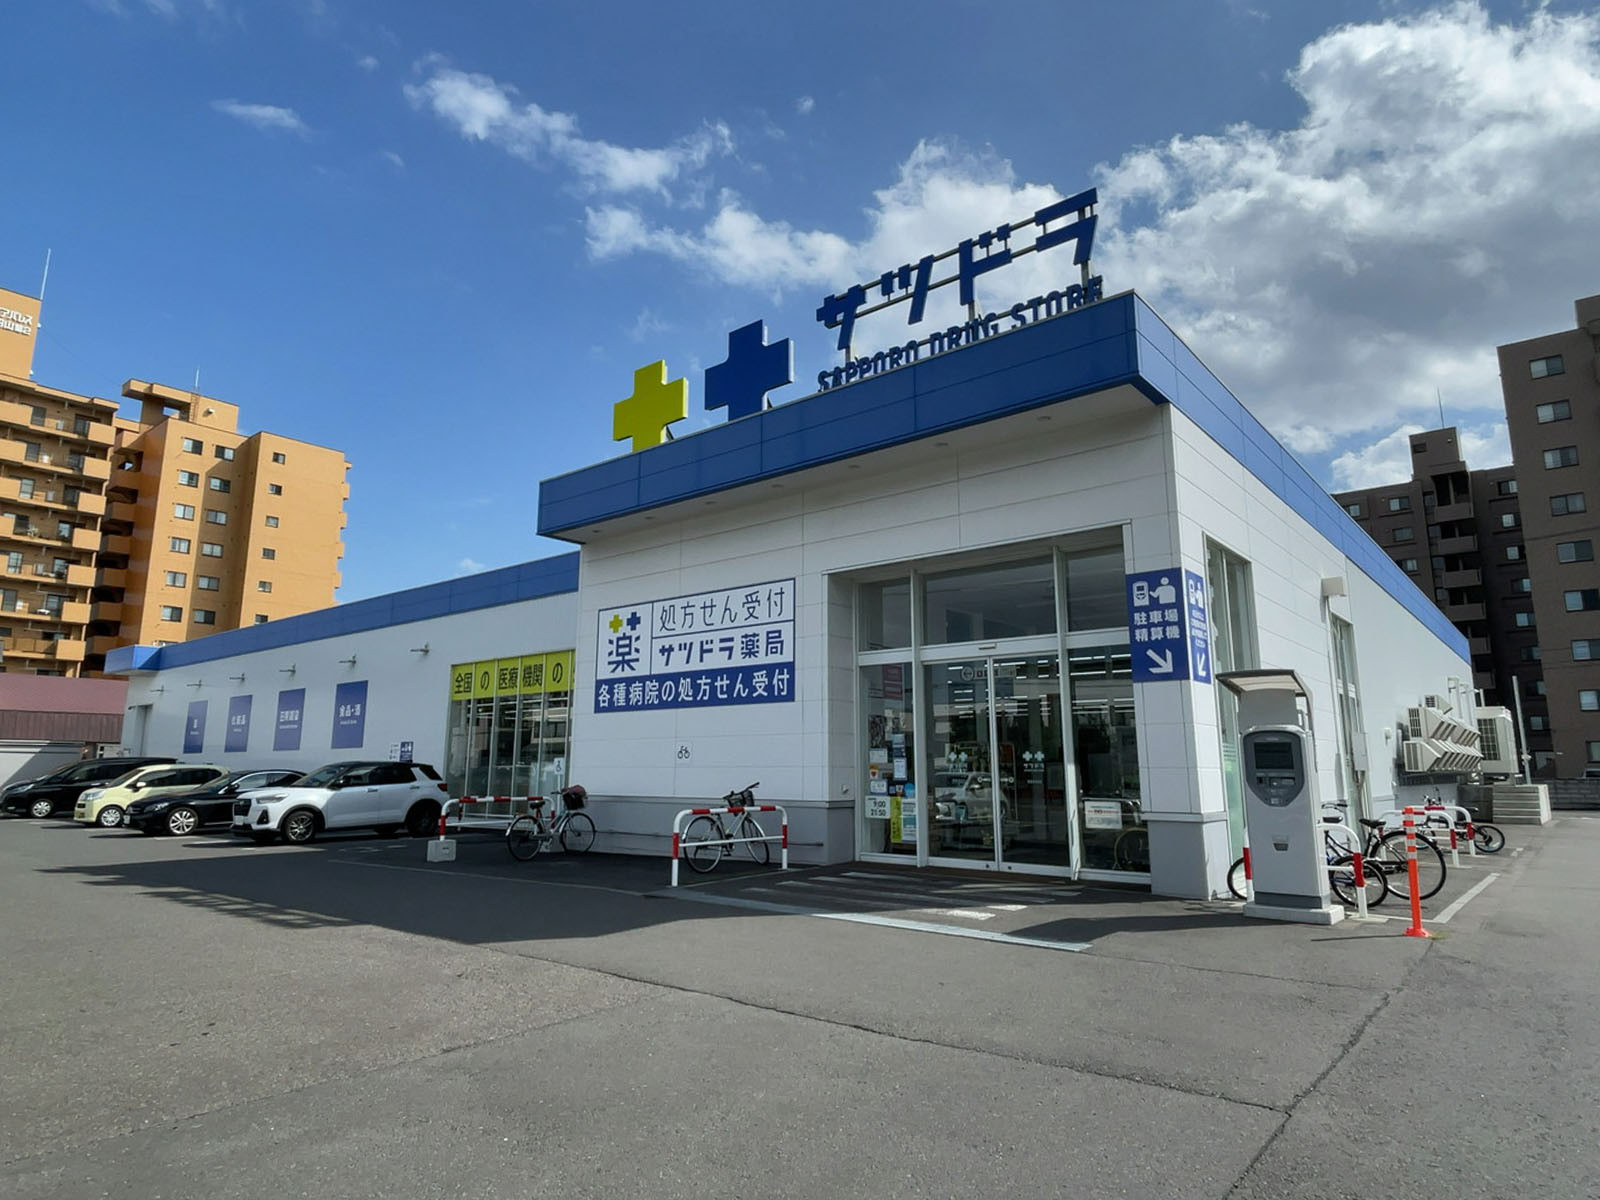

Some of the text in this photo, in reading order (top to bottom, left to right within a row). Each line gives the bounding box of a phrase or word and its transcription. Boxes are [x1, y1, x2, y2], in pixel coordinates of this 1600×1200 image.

[816, 187, 1098, 350] サツドラ
[817, 275, 1103, 392] SAPPORO DRUG STORE
[659, 586, 785, 632] 処方せん受付
[1133, 608, 1179, 626] 駐車場
[658, 629, 785, 667] サツドラ薬局
[1134, 625, 1181, 642] 精算機
[454, 662, 575, 694] 全国の医療機関の
[598, 668, 790, 708] 各種病院の処方せん受付
